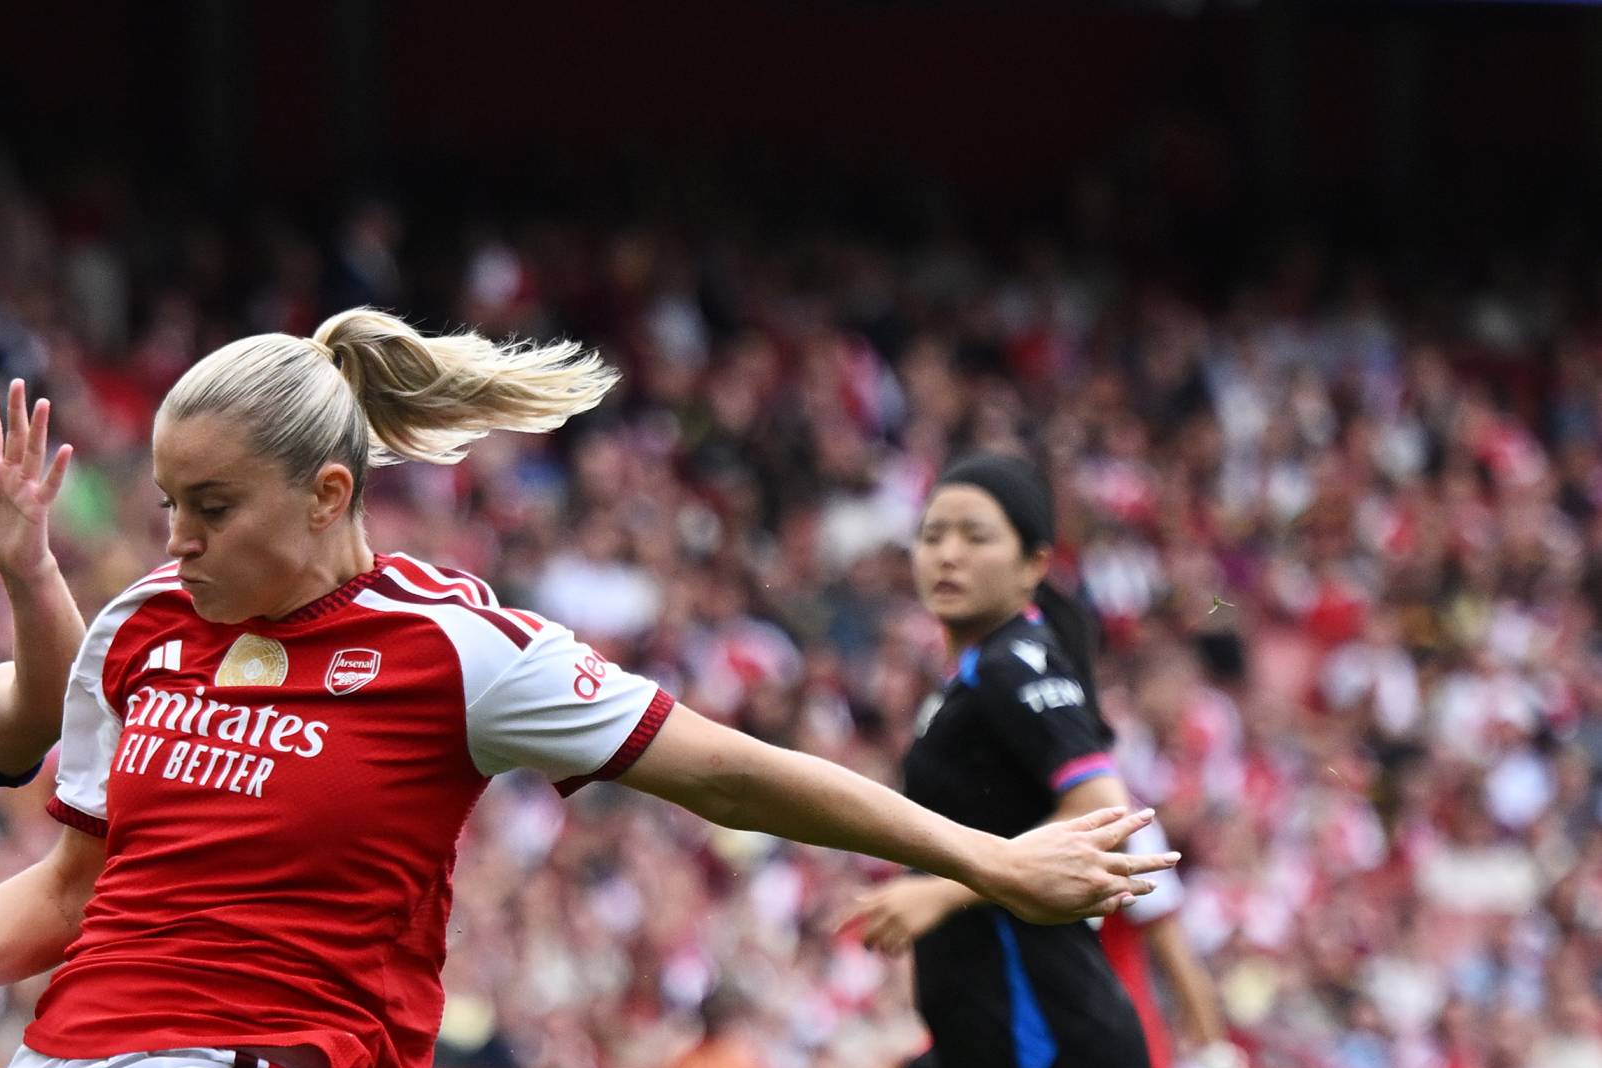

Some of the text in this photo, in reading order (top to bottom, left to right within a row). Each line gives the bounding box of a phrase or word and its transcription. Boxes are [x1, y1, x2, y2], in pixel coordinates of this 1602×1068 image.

[337, 658, 374, 669] Arsenal
[573, 650, 607, 701] de
[116, 733, 275, 798] FLY BETTER
